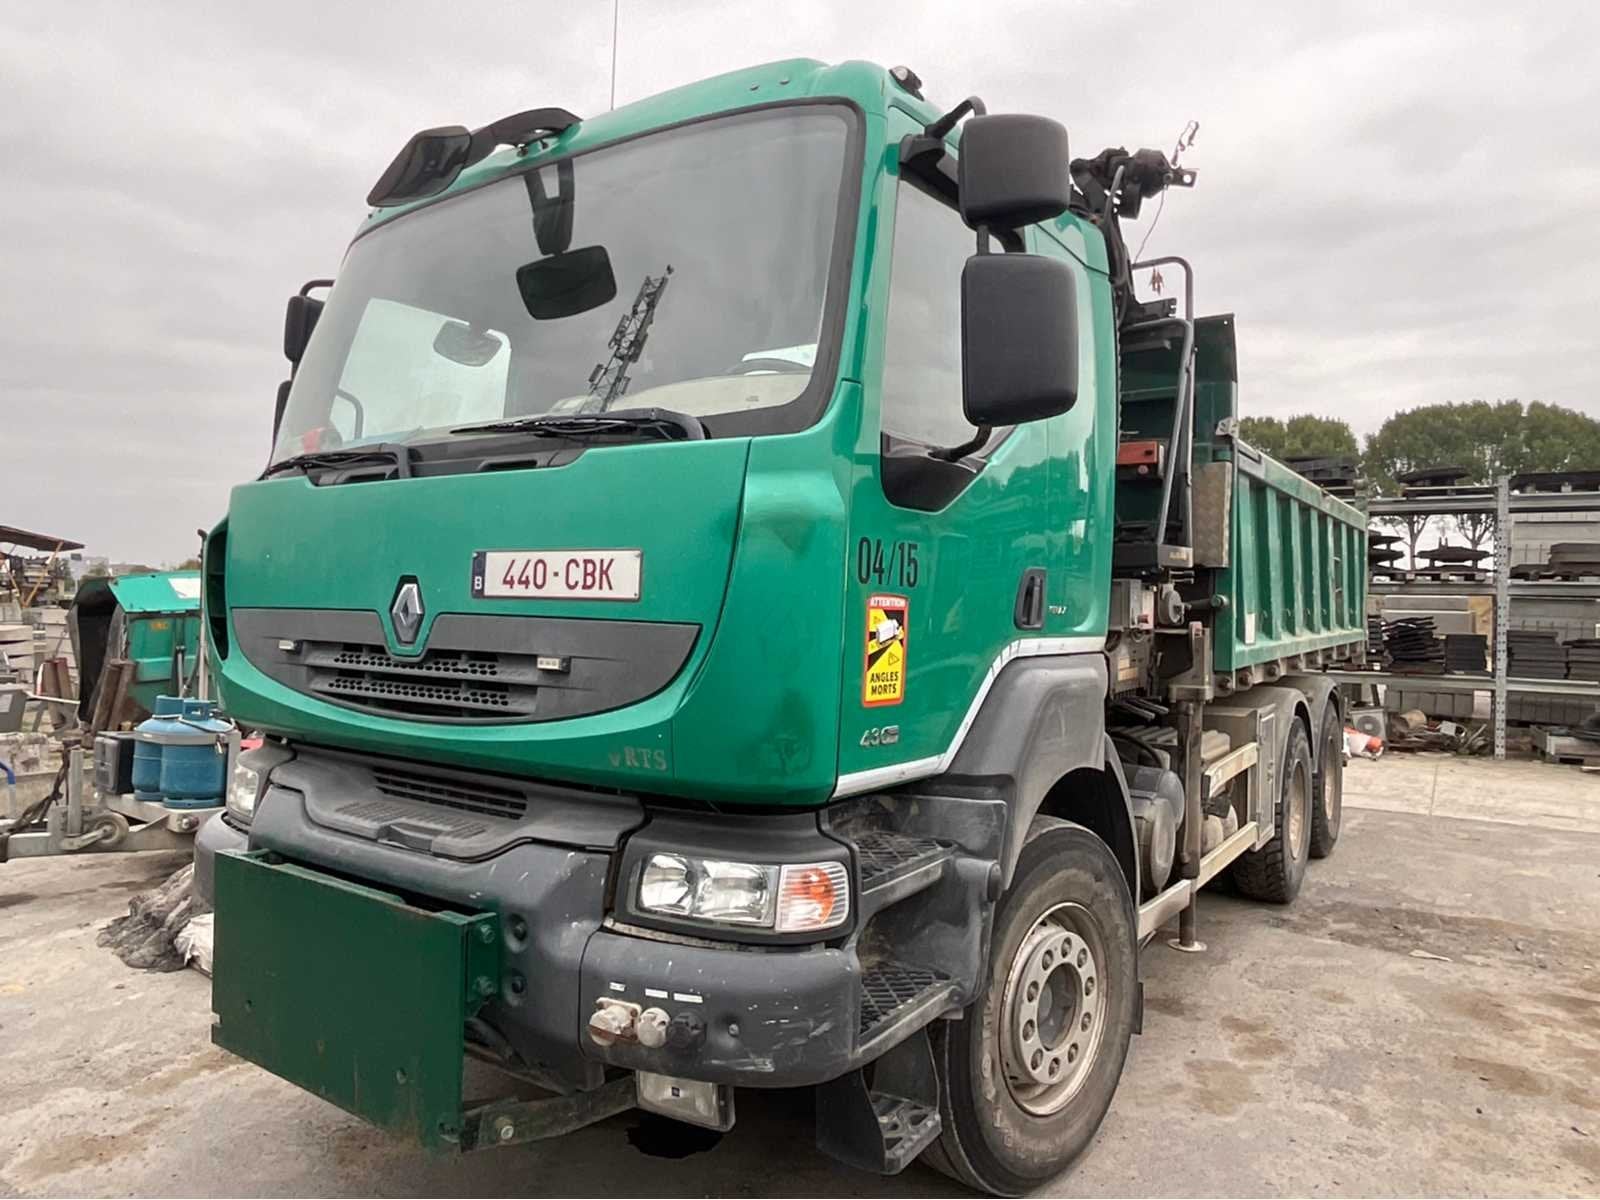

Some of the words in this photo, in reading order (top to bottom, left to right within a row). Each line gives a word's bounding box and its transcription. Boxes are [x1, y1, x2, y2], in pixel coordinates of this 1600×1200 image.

[858, 536, 918, 588] 04/15
[502, 558, 615, 591] 440-CBK
[474, 576, 483, 591] B
[870, 671, 899, 683] ANGLES
[870, 683, 897, 697] MORTS
